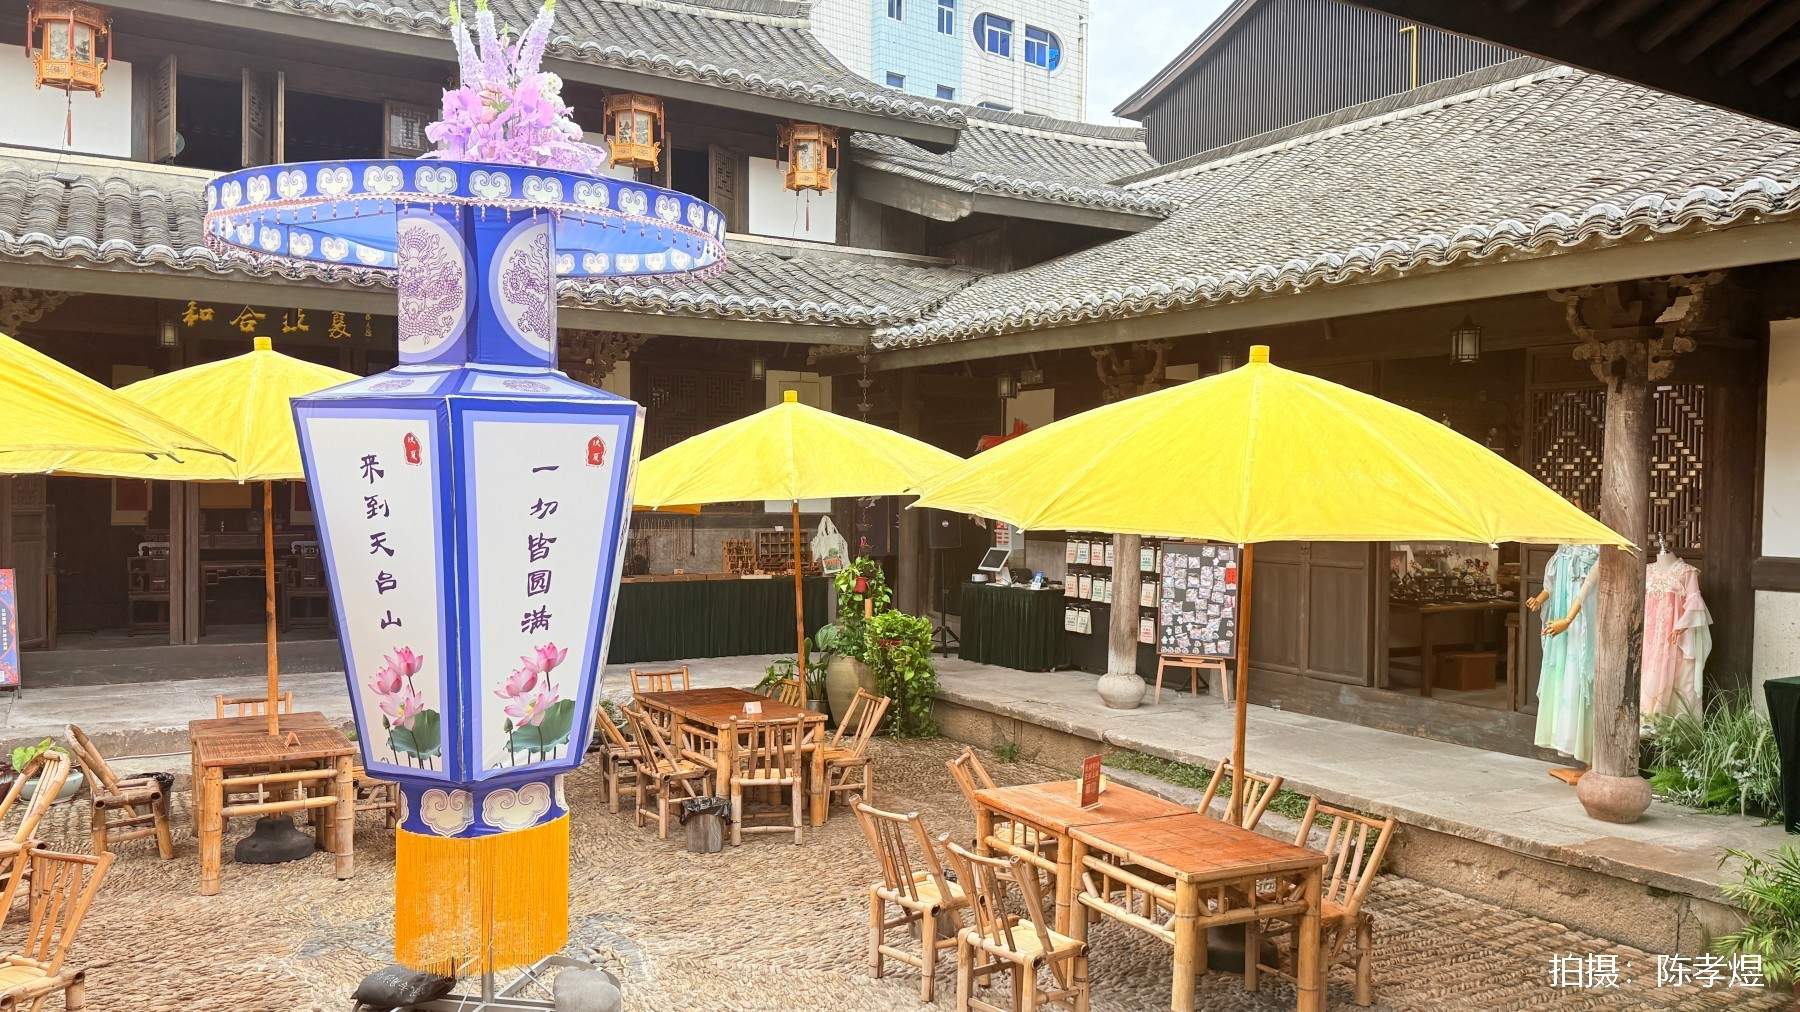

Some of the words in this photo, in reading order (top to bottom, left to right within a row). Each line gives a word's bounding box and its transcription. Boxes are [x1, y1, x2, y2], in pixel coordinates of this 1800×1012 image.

[359, 453, 402, 630] 来到天台山
[520, 463, 560, 636] 一切皆圆满
